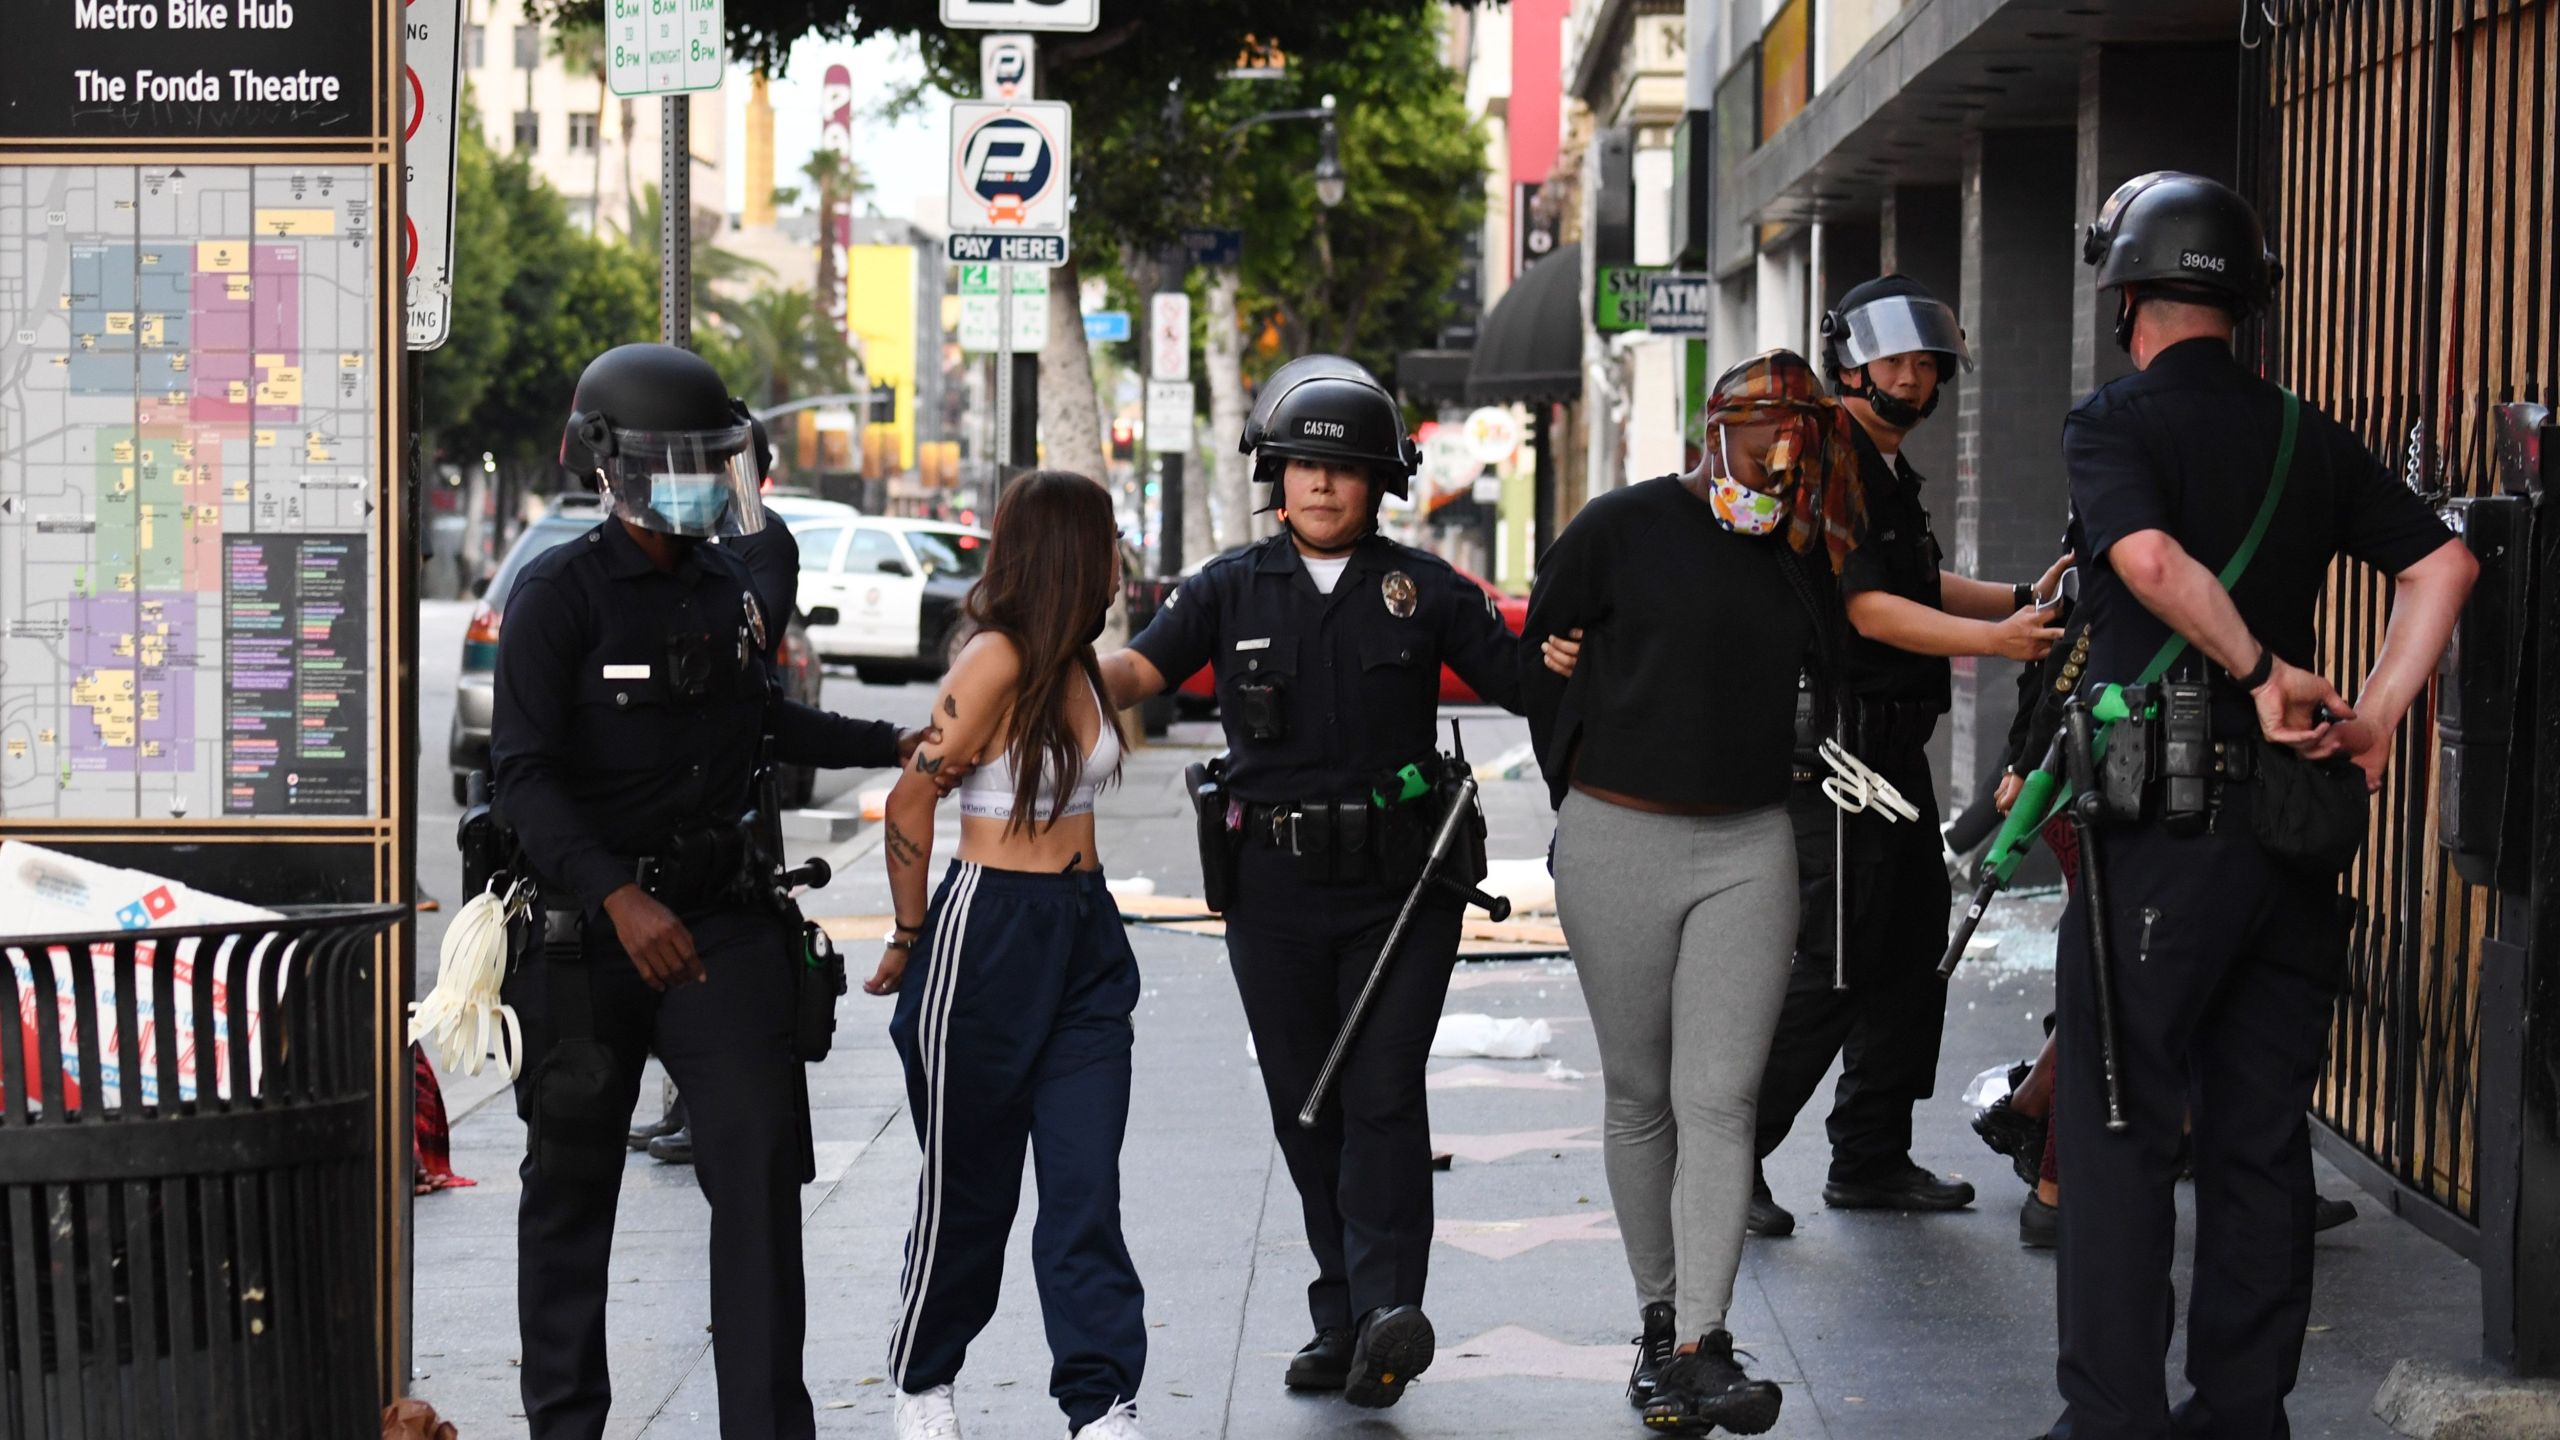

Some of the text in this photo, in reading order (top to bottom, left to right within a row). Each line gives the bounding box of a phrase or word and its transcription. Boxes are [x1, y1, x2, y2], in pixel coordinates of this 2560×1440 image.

[75, 0, 294, 30] Metro Bike Hub
[74, 69, 341, 102] The Fonda Theatre
[953, 237, 1059, 261] PAY HERE
[2181, 252, 2225, 273] 39045
[1609, 272, 1648, 294] SM
[1651, 283, 1708, 314] ATM
[1303, 420, 1345, 440] CASTRO
